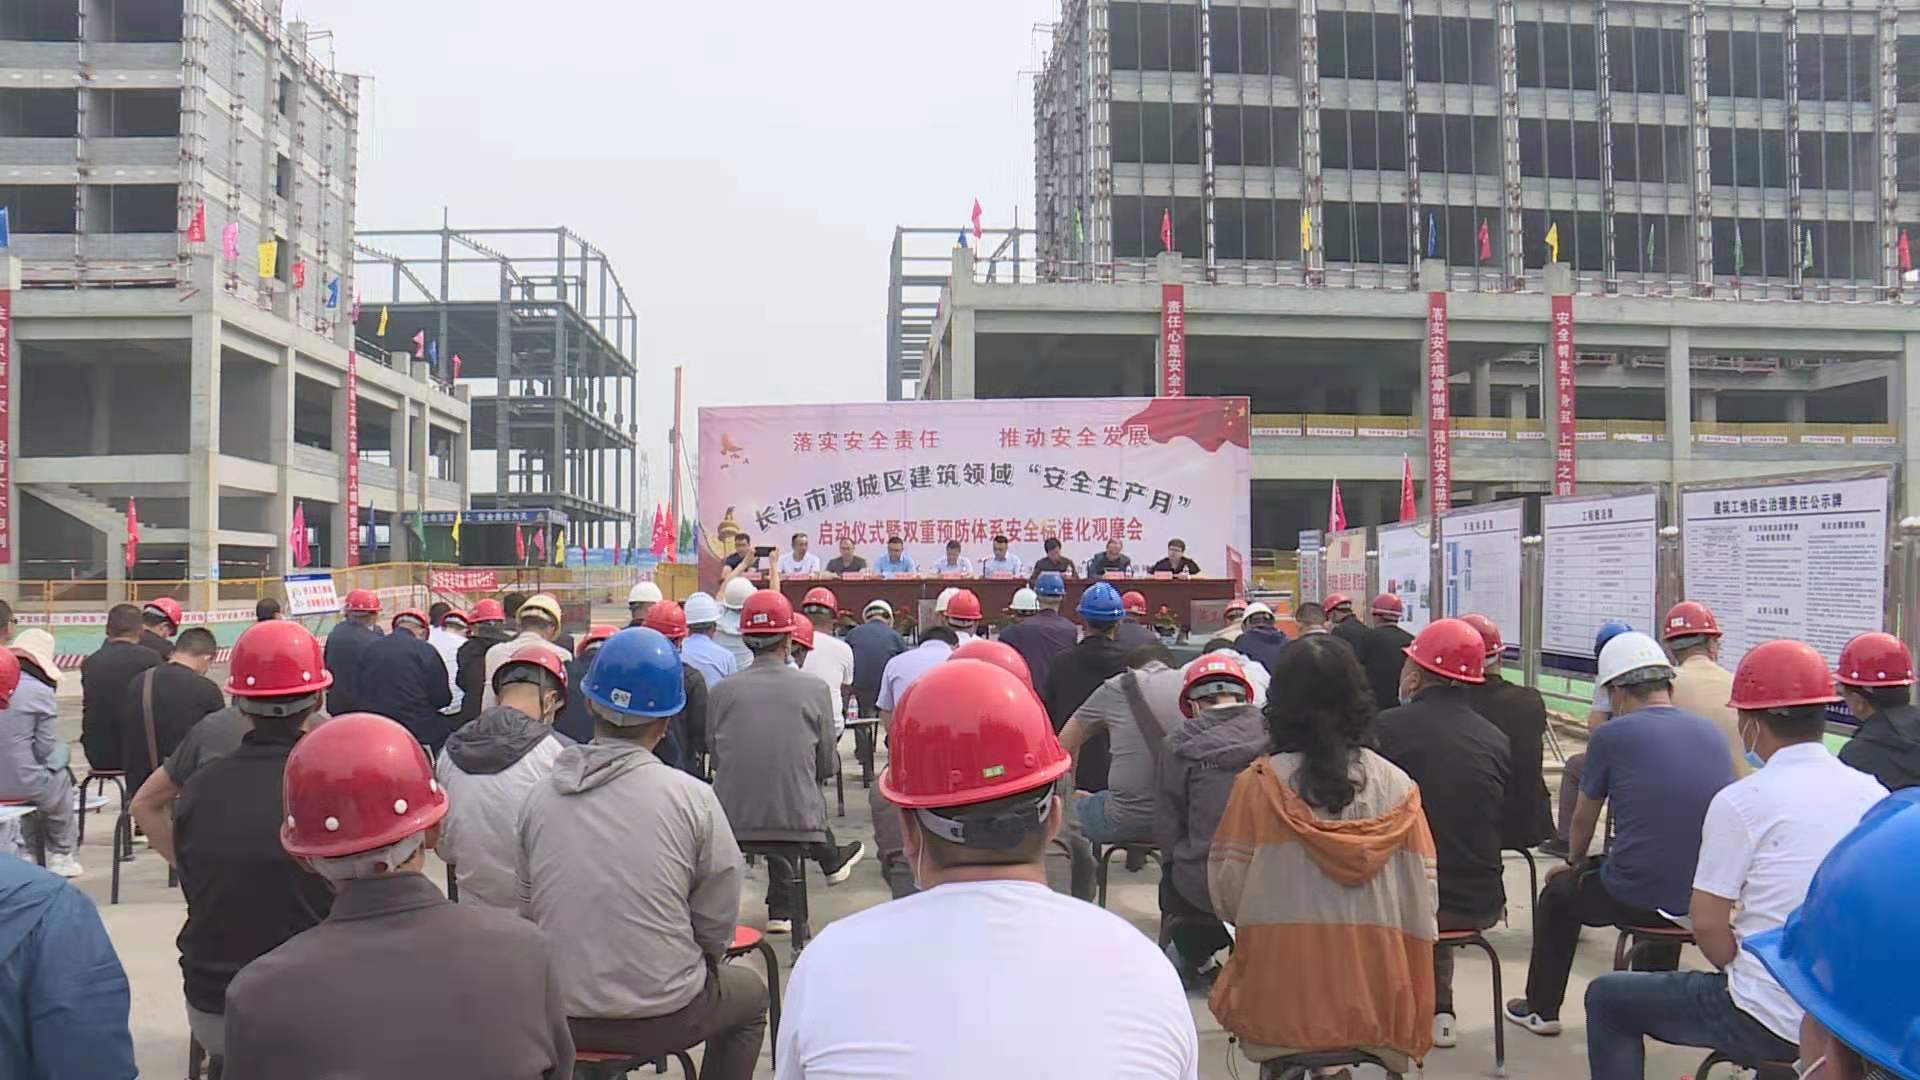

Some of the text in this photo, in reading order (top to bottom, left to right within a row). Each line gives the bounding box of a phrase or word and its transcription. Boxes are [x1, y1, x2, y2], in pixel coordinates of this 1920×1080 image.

[1556, 312, 1572, 424] 安全帽是护身宝
[793, 424, 1150, 452] 落实安全责任 推动安全发展
[1713, 493, 1843, 515] 建筑工地扬尘治理责任公示牌
[818, 516, 1144, 546] 启动仪式暨双重预防体系安全标准化观摩会
